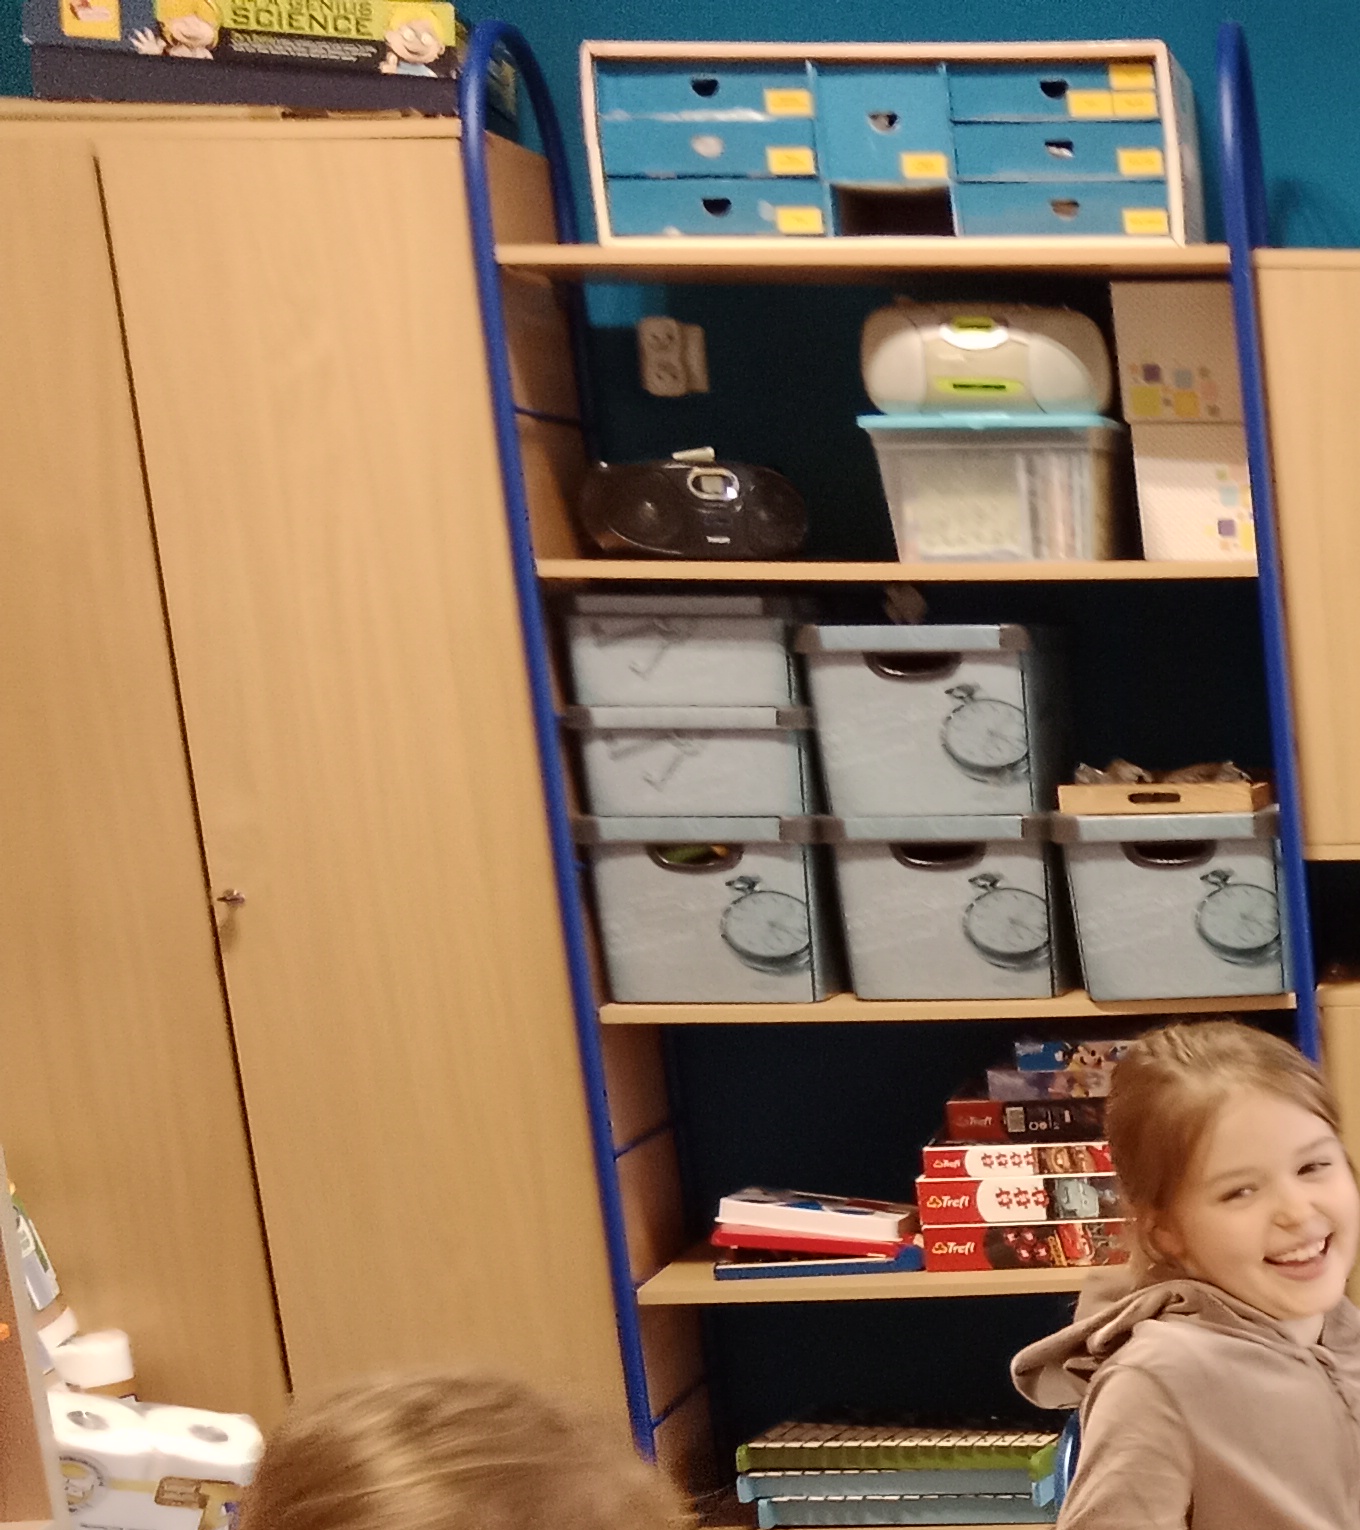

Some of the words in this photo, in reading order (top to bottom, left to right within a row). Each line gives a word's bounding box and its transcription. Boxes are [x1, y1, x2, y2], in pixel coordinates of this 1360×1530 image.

[231, 6, 374, 37] SCIENCE
[941, 1195, 970, 1209] Trefl
[946, 1242, 975, 1255] Trefl
